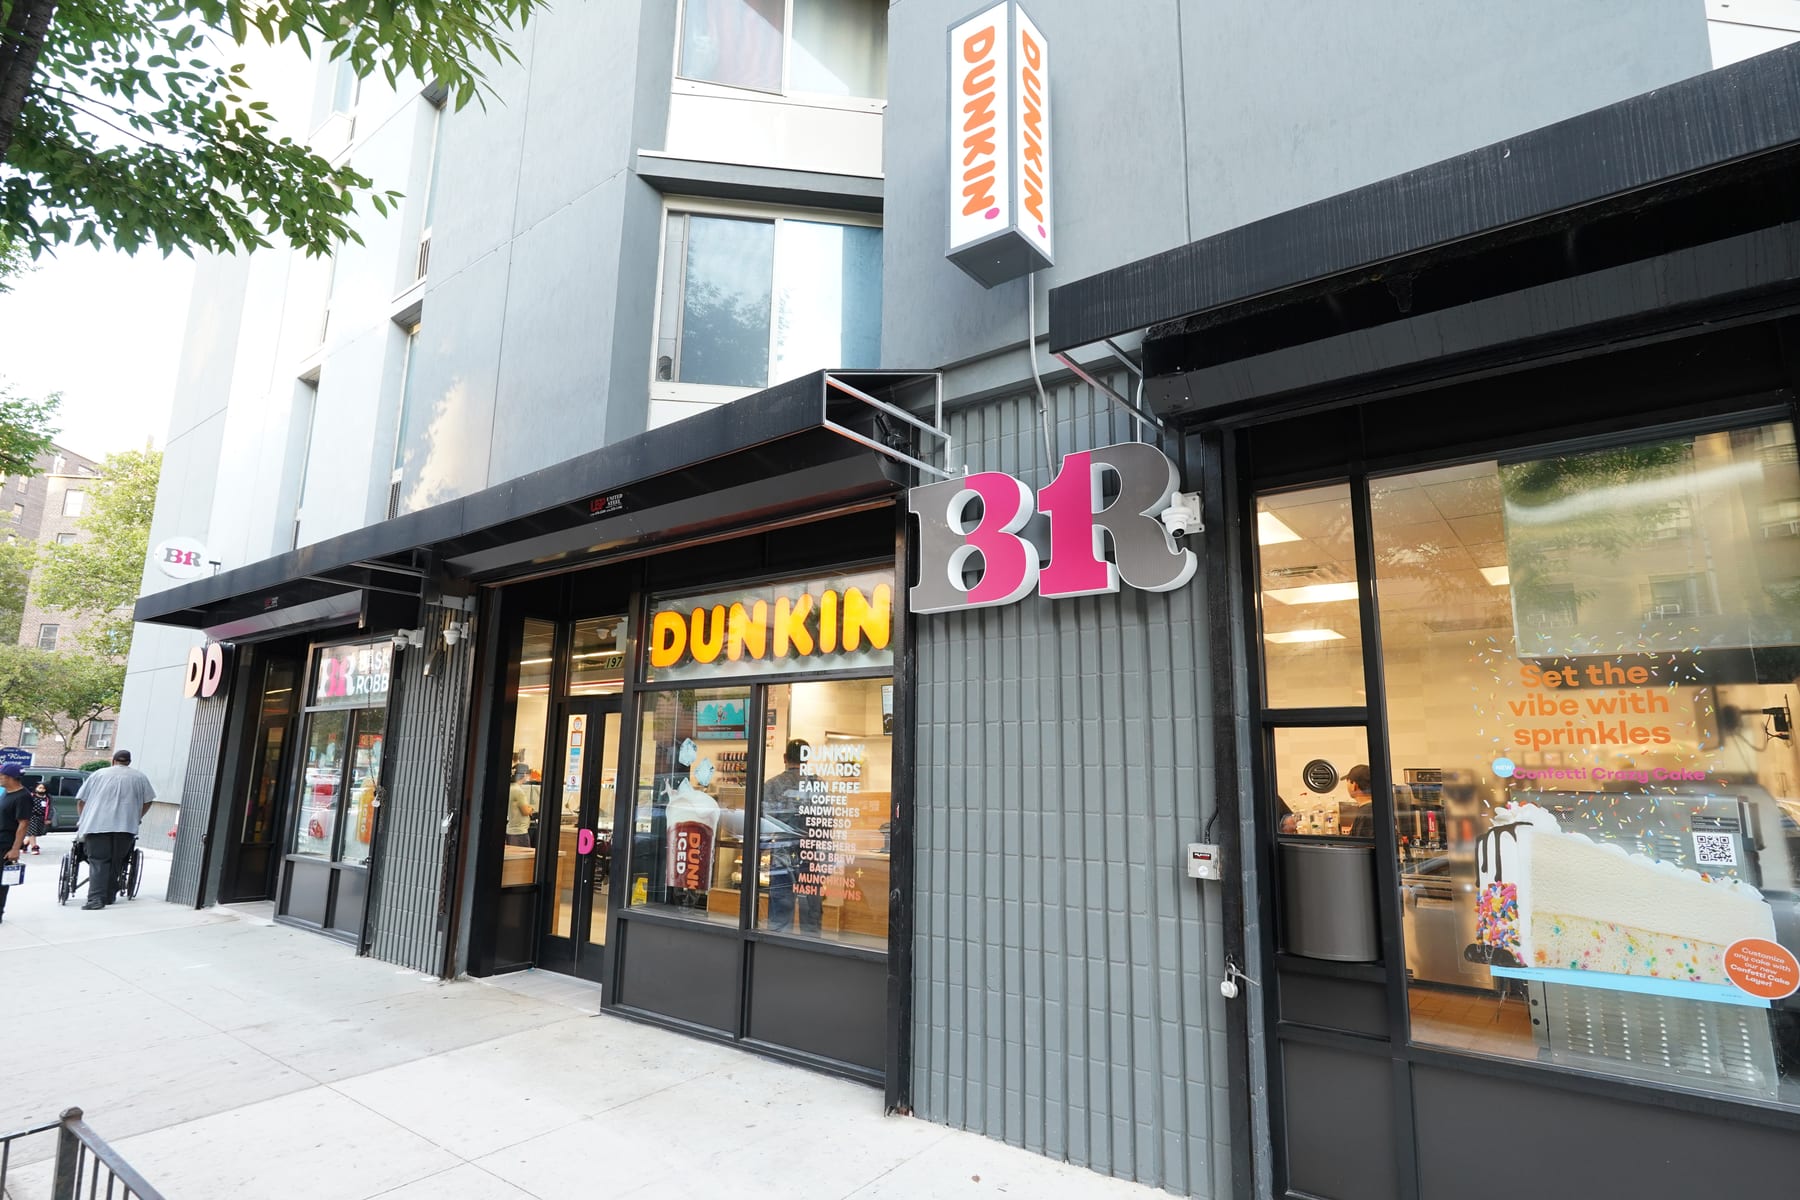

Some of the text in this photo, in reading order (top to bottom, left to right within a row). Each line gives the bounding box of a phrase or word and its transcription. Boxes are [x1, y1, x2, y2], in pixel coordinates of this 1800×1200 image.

[164, 547, 202, 567] BR
[651, 583, 891, 668] DUNKIN
[606, 657, 623, 668] 197
[184, 643, 223, 699] DD
[1520, 661, 1649, 688] Set the
[1508, 689, 1669, 717] vibe with
[1513, 720, 1672, 752] sprinkles
[799, 763, 861, 777] REWARDS
[1512, 767, 1706, 783] Confetti Crazy Cake
[798, 781, 861, 794] EARN FREE
[811, 795, 847, 806] COFFEE
[798, 806, 860, 818] SANDWICHES
[805, 817, 851, 829] ESPRESSO
[808, 828, 847, 840] DONUTS
[800, 839, 857, 852] REFRESHERS
[676, 832, 687, 875] ICED
[800, 851, 855, 865] COLD BREW
[809, 862, 845, 875] BAGELS
[792, 883, 817, 896] HASH
[1742, 947, 1785, 963] Customize
[1733, 953, 1791, 972] any cake with
[1730, 964, 1790, 986] Confetti Cake
[1760, 967, 1777, 975] new
[1745, 975, 1772, 987] Layer!
